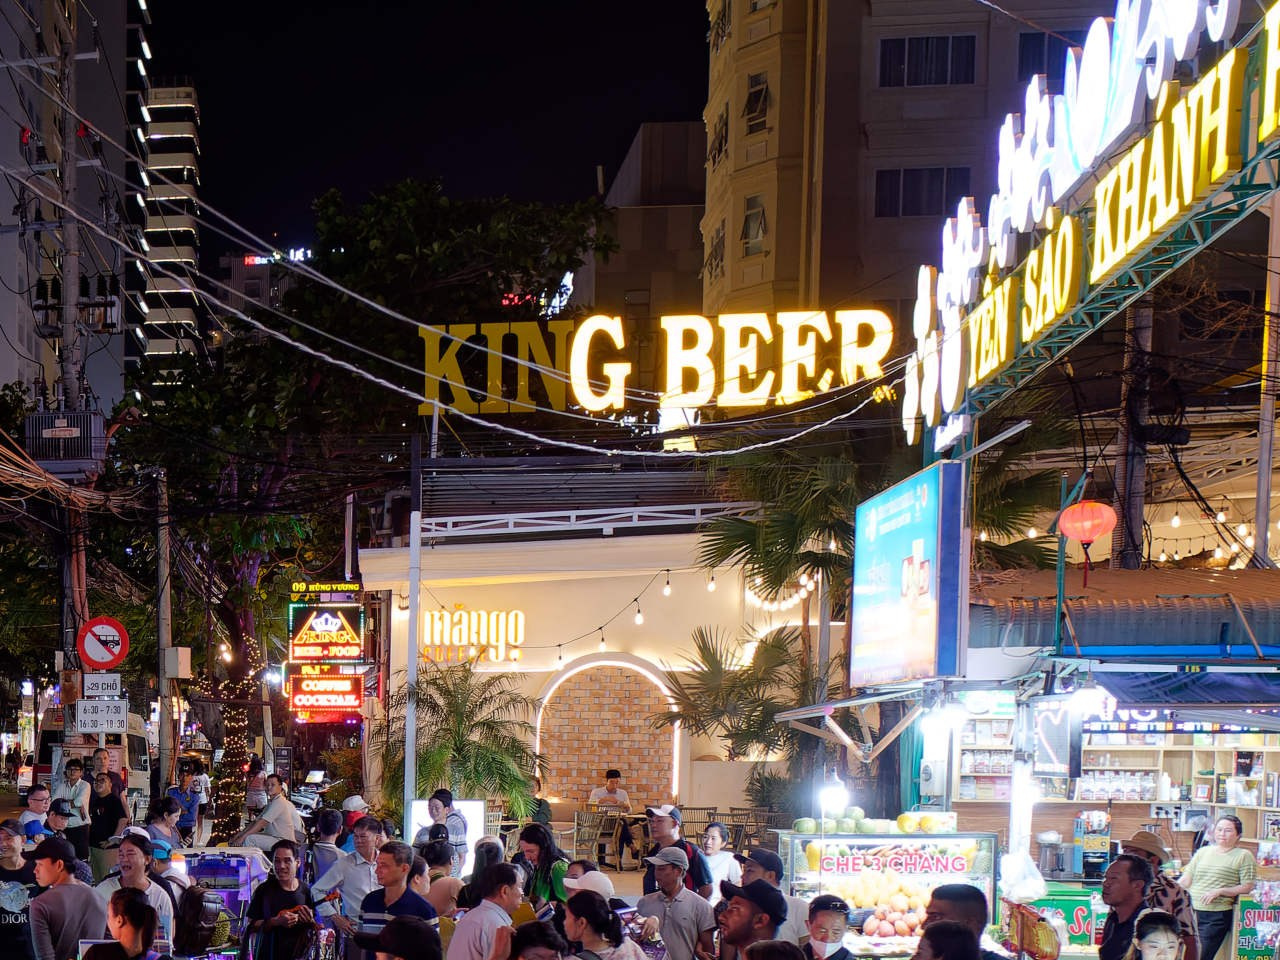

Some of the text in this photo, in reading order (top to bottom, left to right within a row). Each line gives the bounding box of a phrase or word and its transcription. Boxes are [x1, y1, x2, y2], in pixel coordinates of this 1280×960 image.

[1090, 80, 1238, 284] KHÁNH
[418, 309, 894, 416] KING BEER
[292, 582, 306, 592] 09
[306, 630, 348, 643] KING
[329, 645, 360, 657] FOOD
[294, 694, 360, 706] COCKTAIL
[83, 705, 99, 714] 6:30
[106, 705, 121, 714] 7:30
[80, 719, 99, 728] 16:30
[871, 857, 881, 871] 3
[1, 913, 28, 924] DIOR
